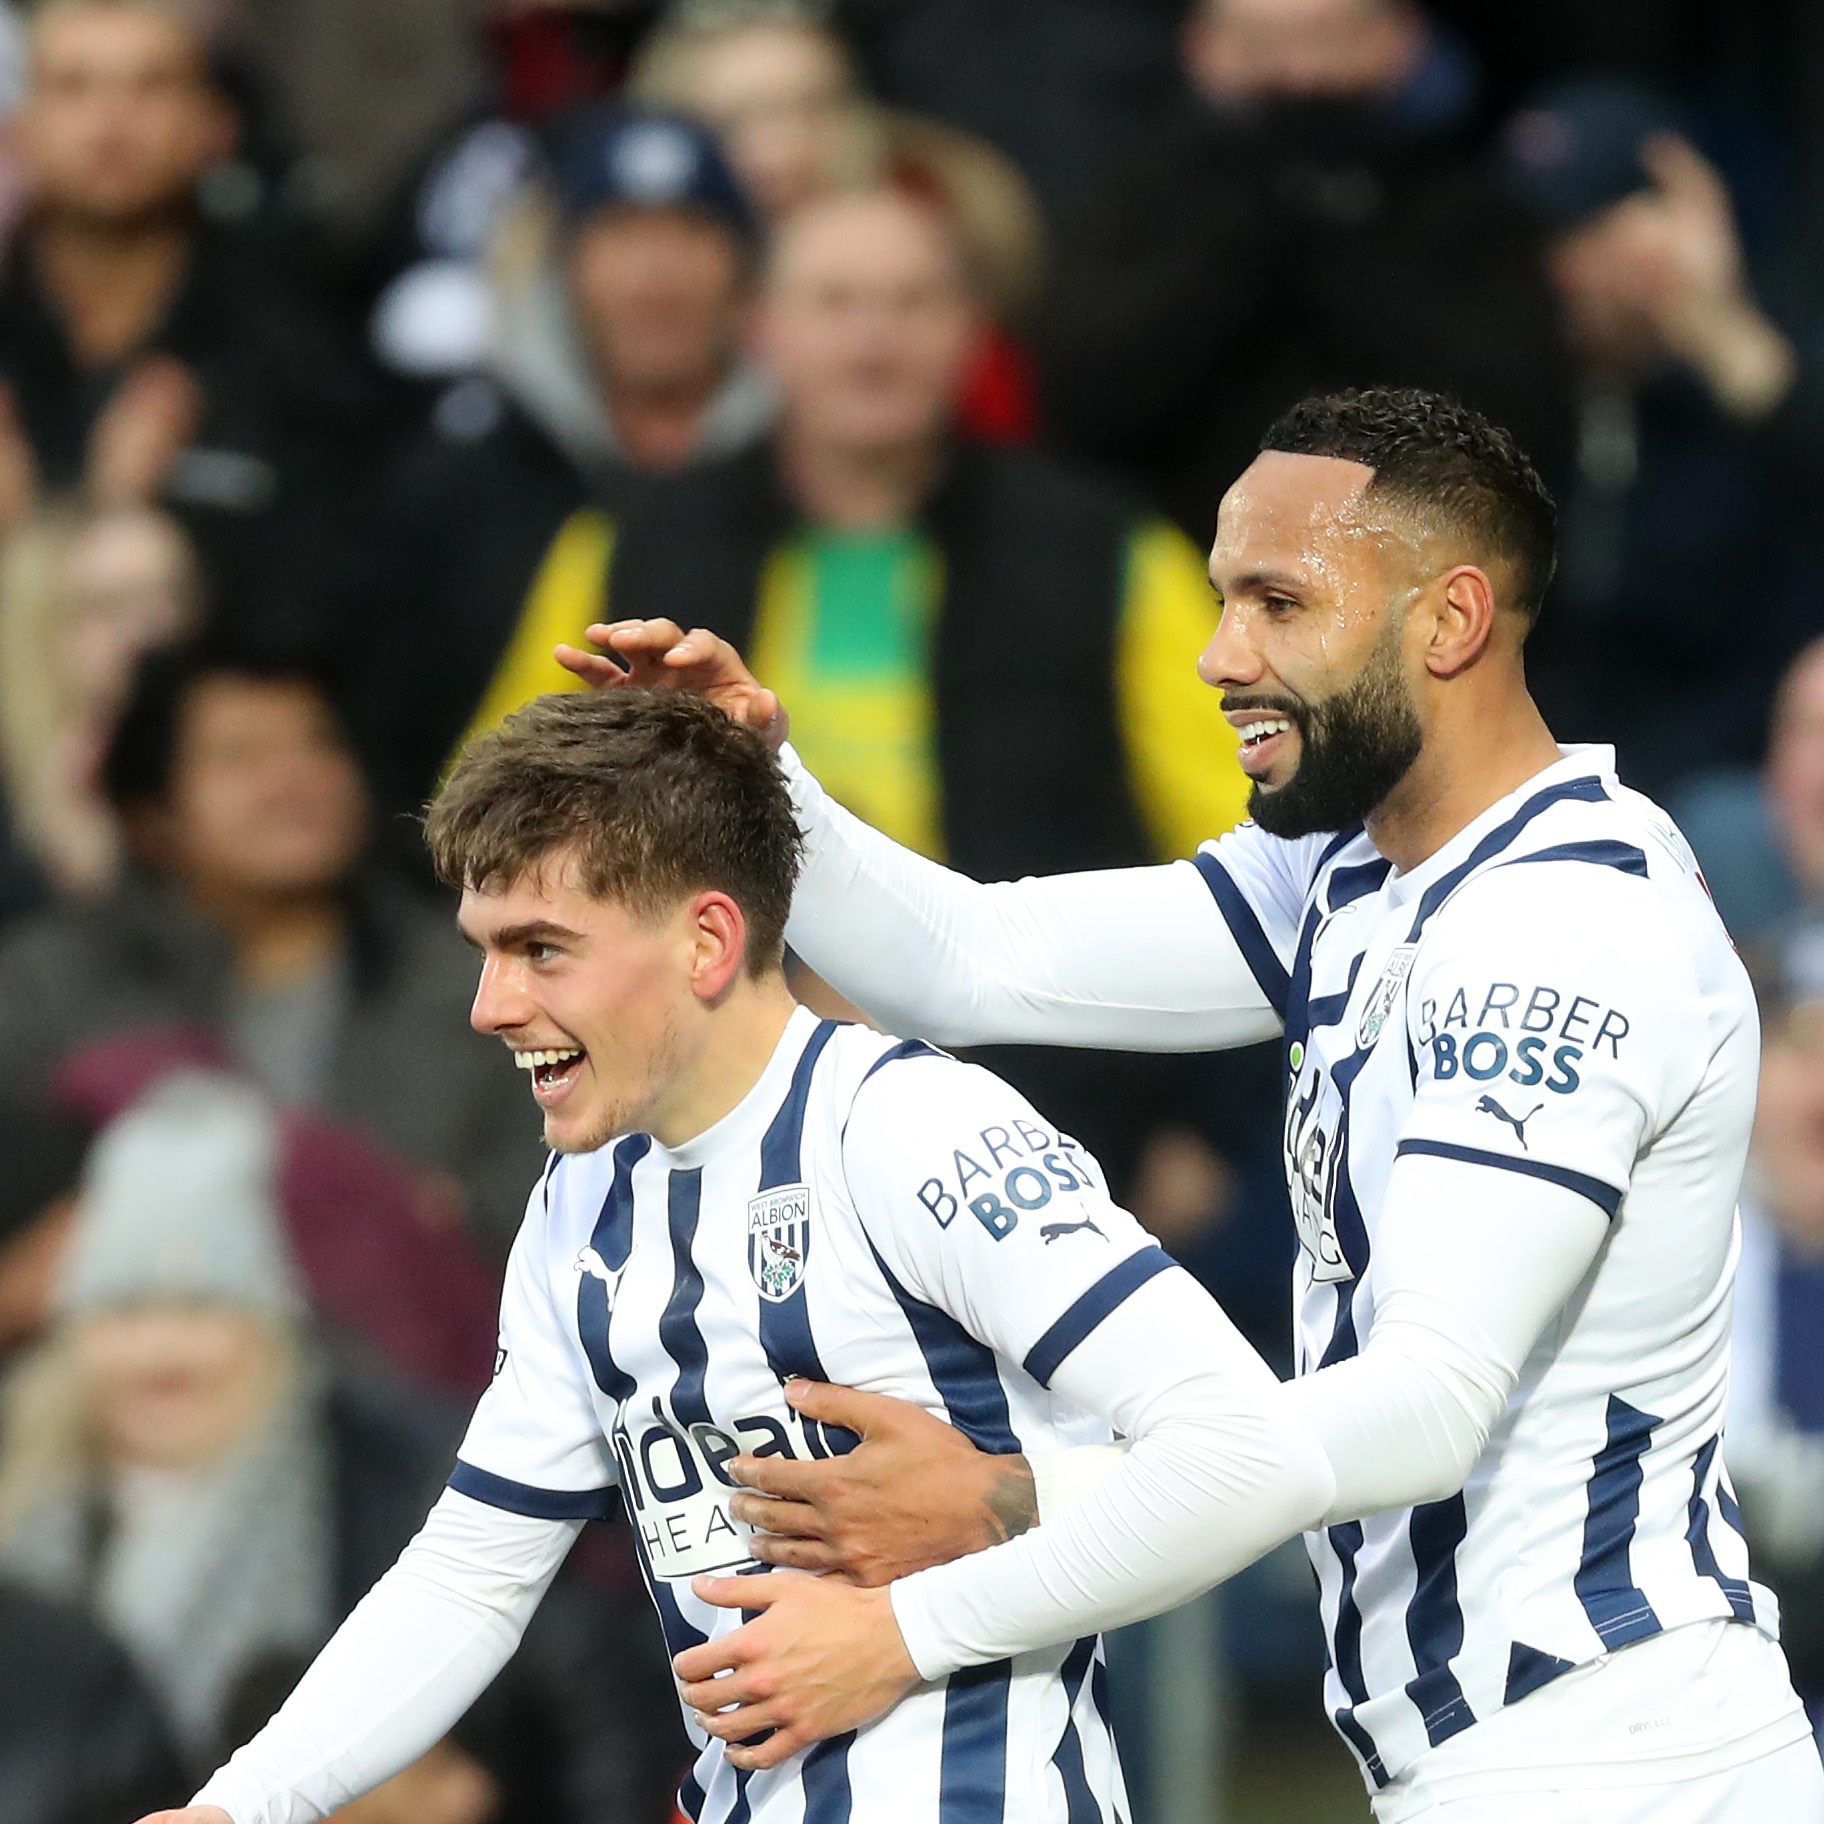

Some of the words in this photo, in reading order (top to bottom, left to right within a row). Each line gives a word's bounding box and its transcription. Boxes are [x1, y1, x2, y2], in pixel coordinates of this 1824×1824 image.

[1418, 983, 1630, 1060] BARBER
[1432, 1031, 1584, 1095] BOSS
[751, 1200, 805, 1229] ALBION
